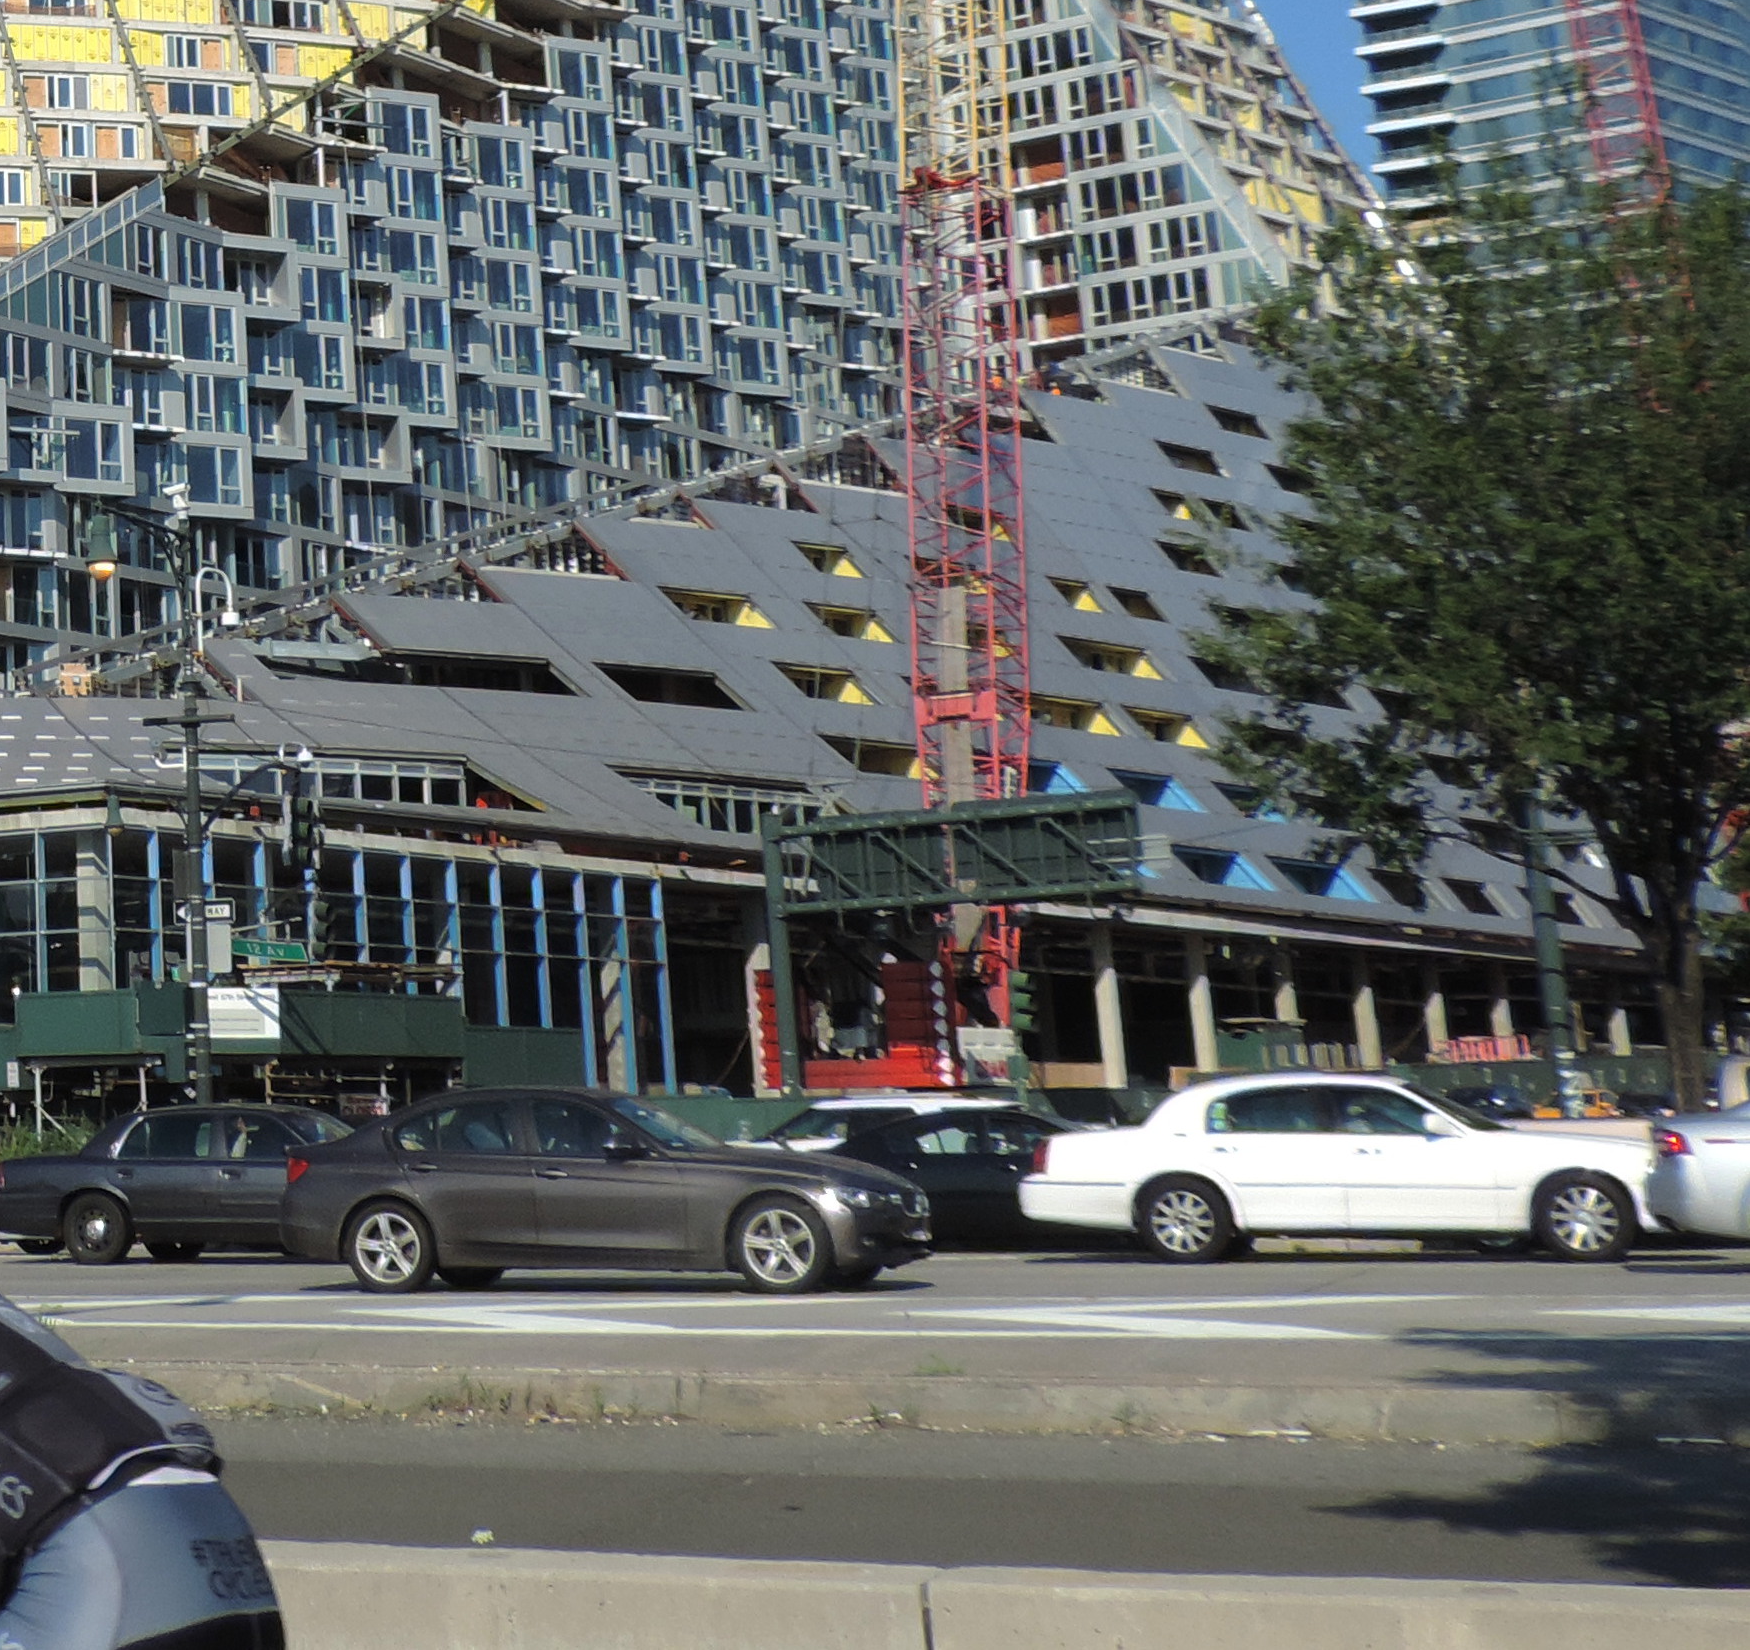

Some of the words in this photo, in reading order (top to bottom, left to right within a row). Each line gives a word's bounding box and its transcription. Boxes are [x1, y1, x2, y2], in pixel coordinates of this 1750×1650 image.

[207, 905, 226, 915] WAY
[246, 942, 262, 955] 12
[266, 945, 285, 956] AV
